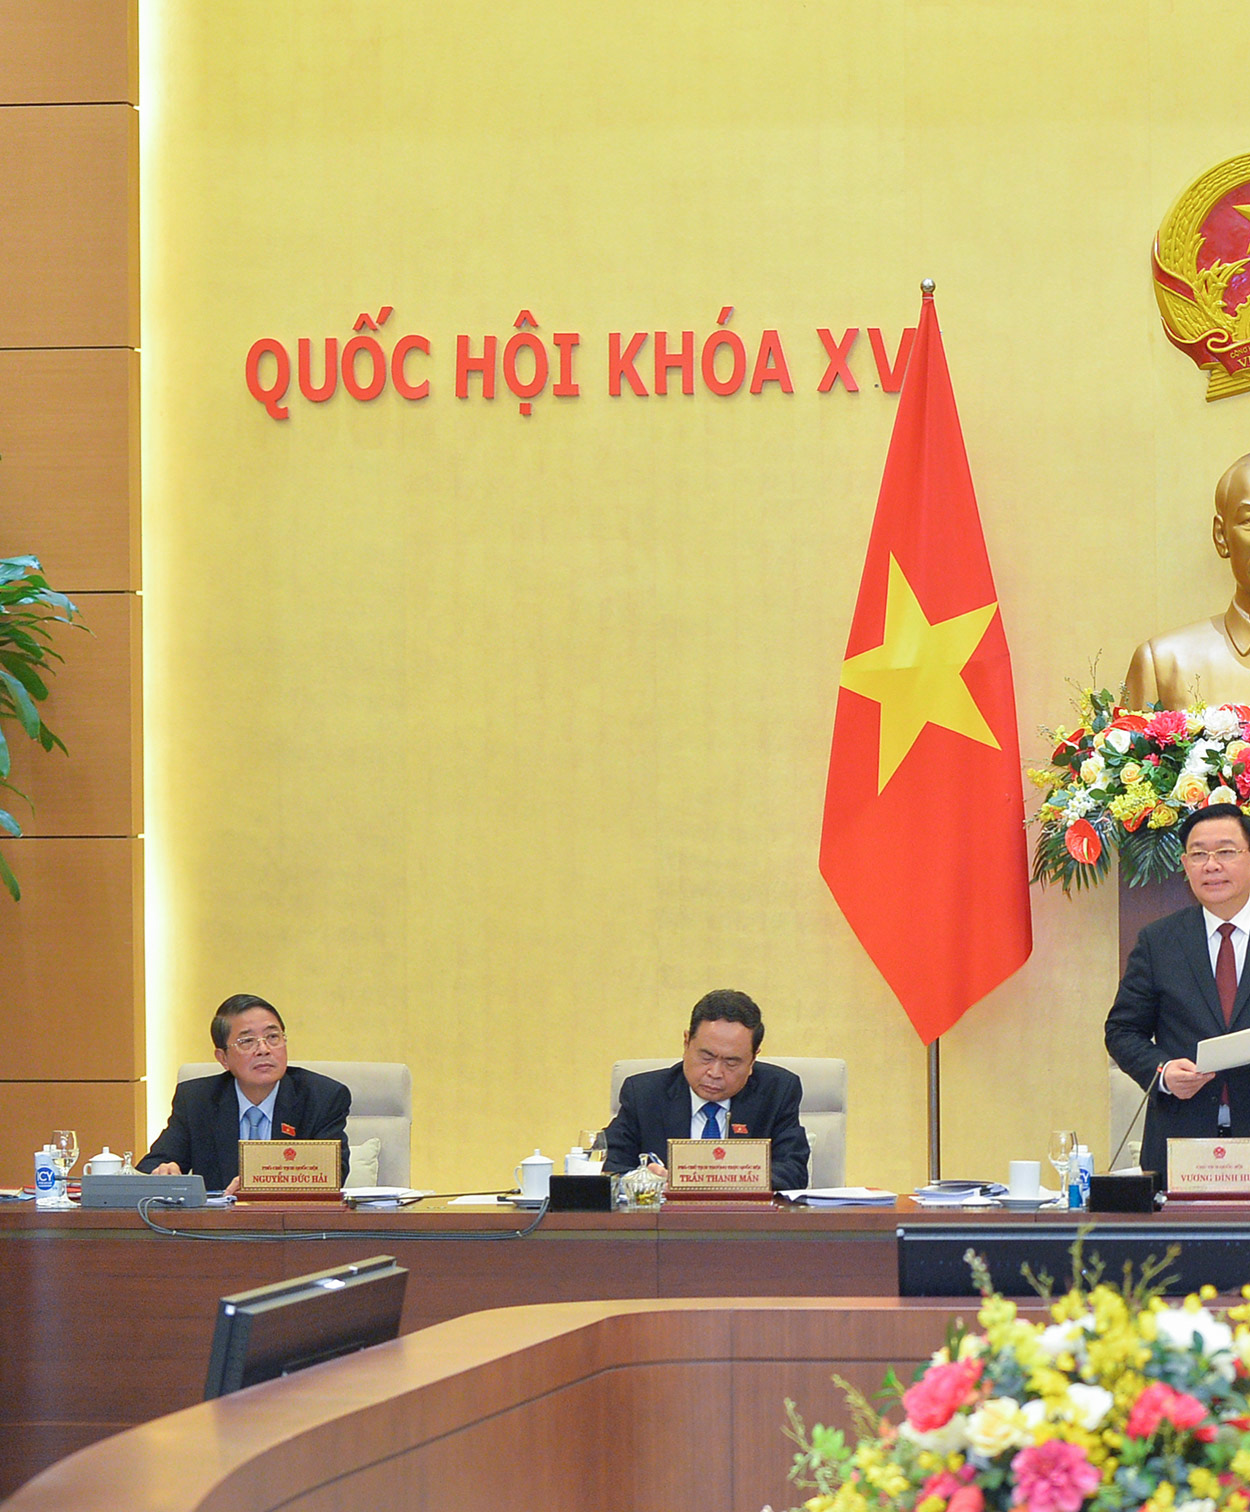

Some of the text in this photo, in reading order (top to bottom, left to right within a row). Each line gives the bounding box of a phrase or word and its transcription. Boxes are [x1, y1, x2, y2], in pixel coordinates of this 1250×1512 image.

[246, 307, 917, 419] QUỐC HỘI KHÓA XV
[252, 1172, 328, 1183] NGUYỄN ĐỨC HẢI
[706, 1175, 737, 1183] THANH
[1181, 1174, 1212, 1182] VƯƠNG
